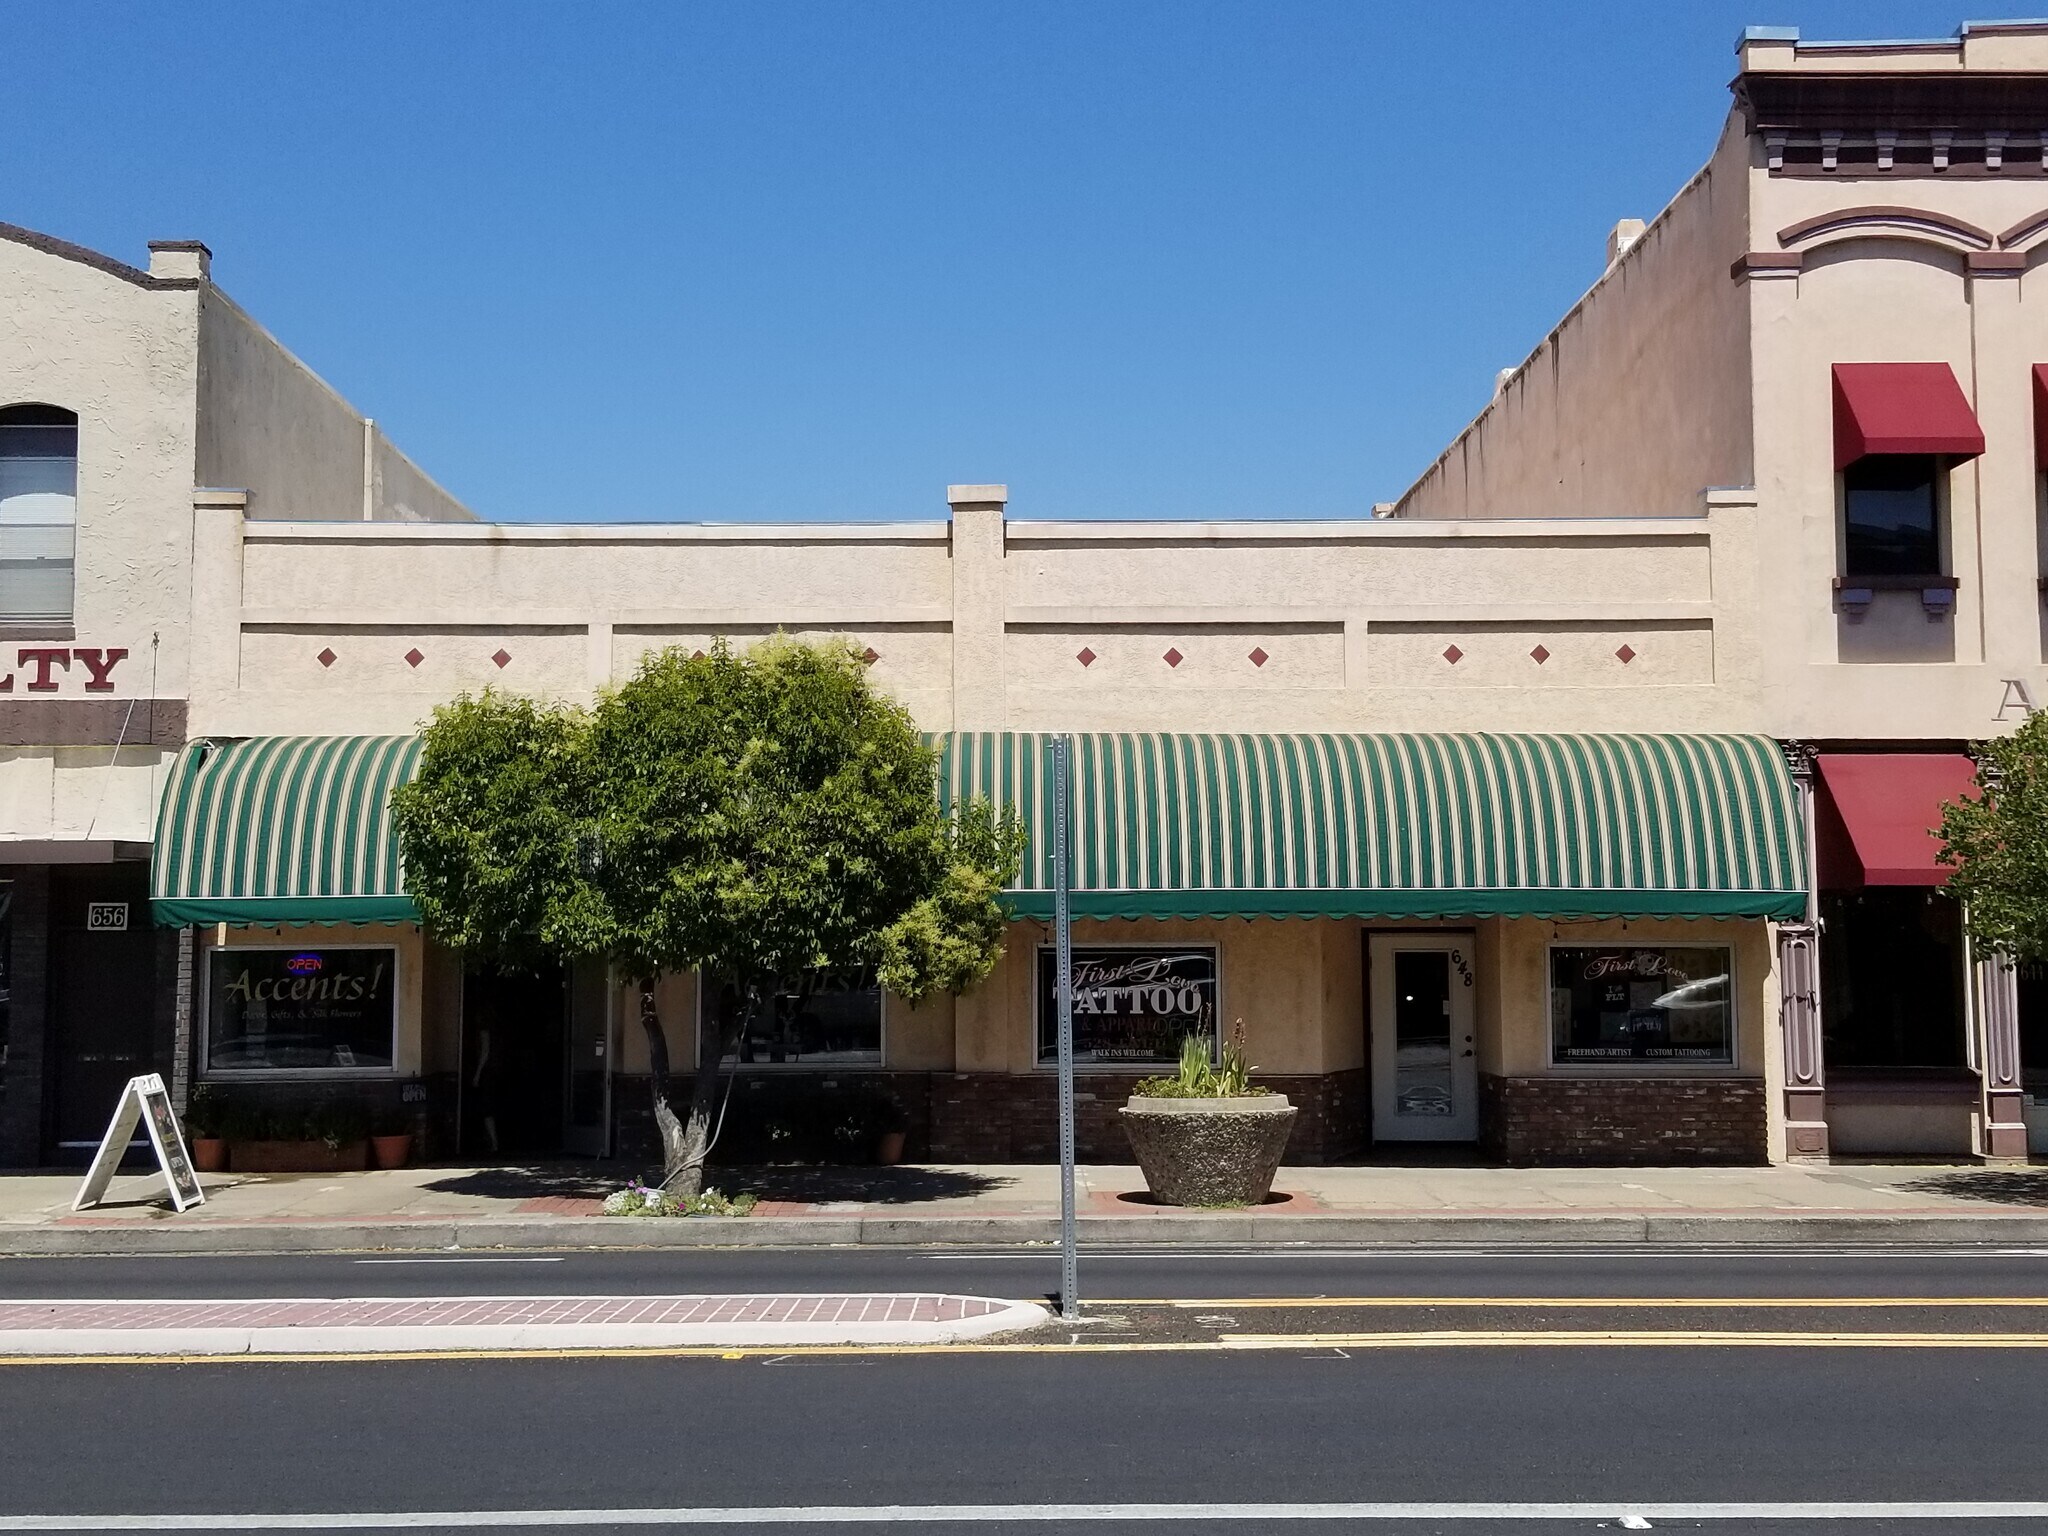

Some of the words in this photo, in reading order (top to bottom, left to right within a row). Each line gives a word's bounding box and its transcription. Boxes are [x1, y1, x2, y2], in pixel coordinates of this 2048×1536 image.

[92, 907, 124, 926] 656
[287, 959, 322, 971] OPEN
[1052, 957, 1125, 990] First
[1129, 957, 1199, 993] Love
[1452, 950, 1472, 987] 648
[1584, 955, 1634, 980] First
[1639, 953, 1688, 980] Love
[223, 963, 383, 1002] Accents!
[1123, 1048, 1155, 1057] WELCOME
[1567, 1048, 1605, 1057] FREEHAND
[1606, 1048, 1632, 1057] ARTIST
[1645, 1048, 1672, 1057] CUSTOM
[1674, 1048, 1711, 1057] TATTOOING
